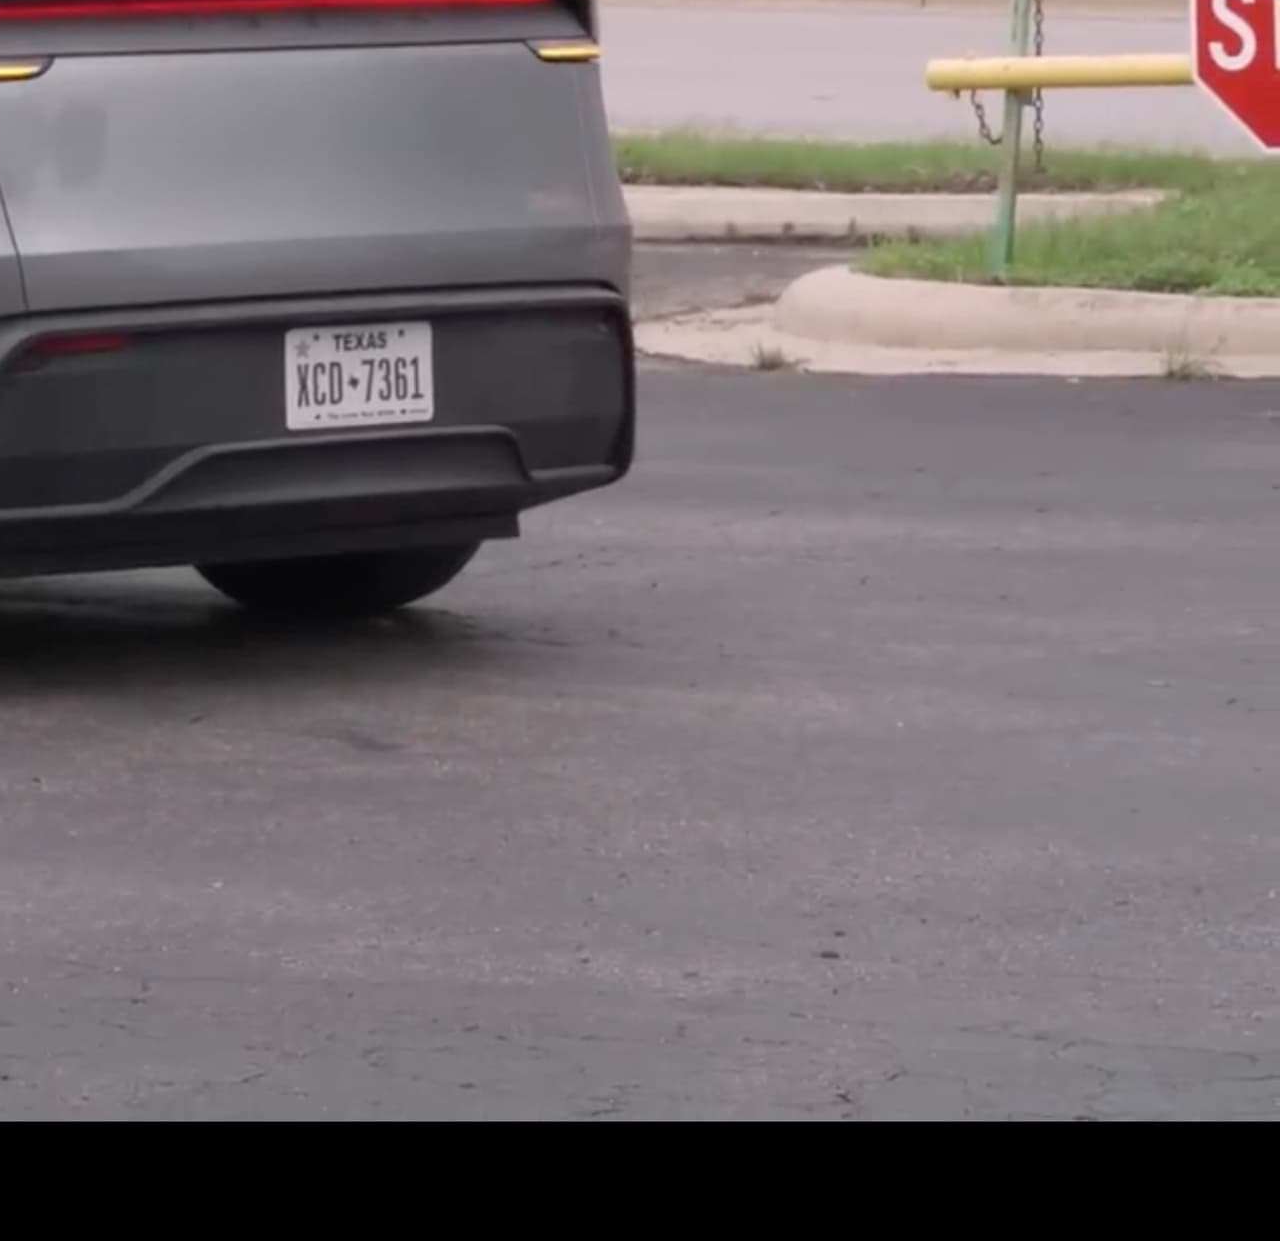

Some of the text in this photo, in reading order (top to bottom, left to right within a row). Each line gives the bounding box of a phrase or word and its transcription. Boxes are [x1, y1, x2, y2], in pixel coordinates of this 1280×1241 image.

[333, 331, 387, 352] TEXAS
[297, 356, 424, 408] XCD 7361
